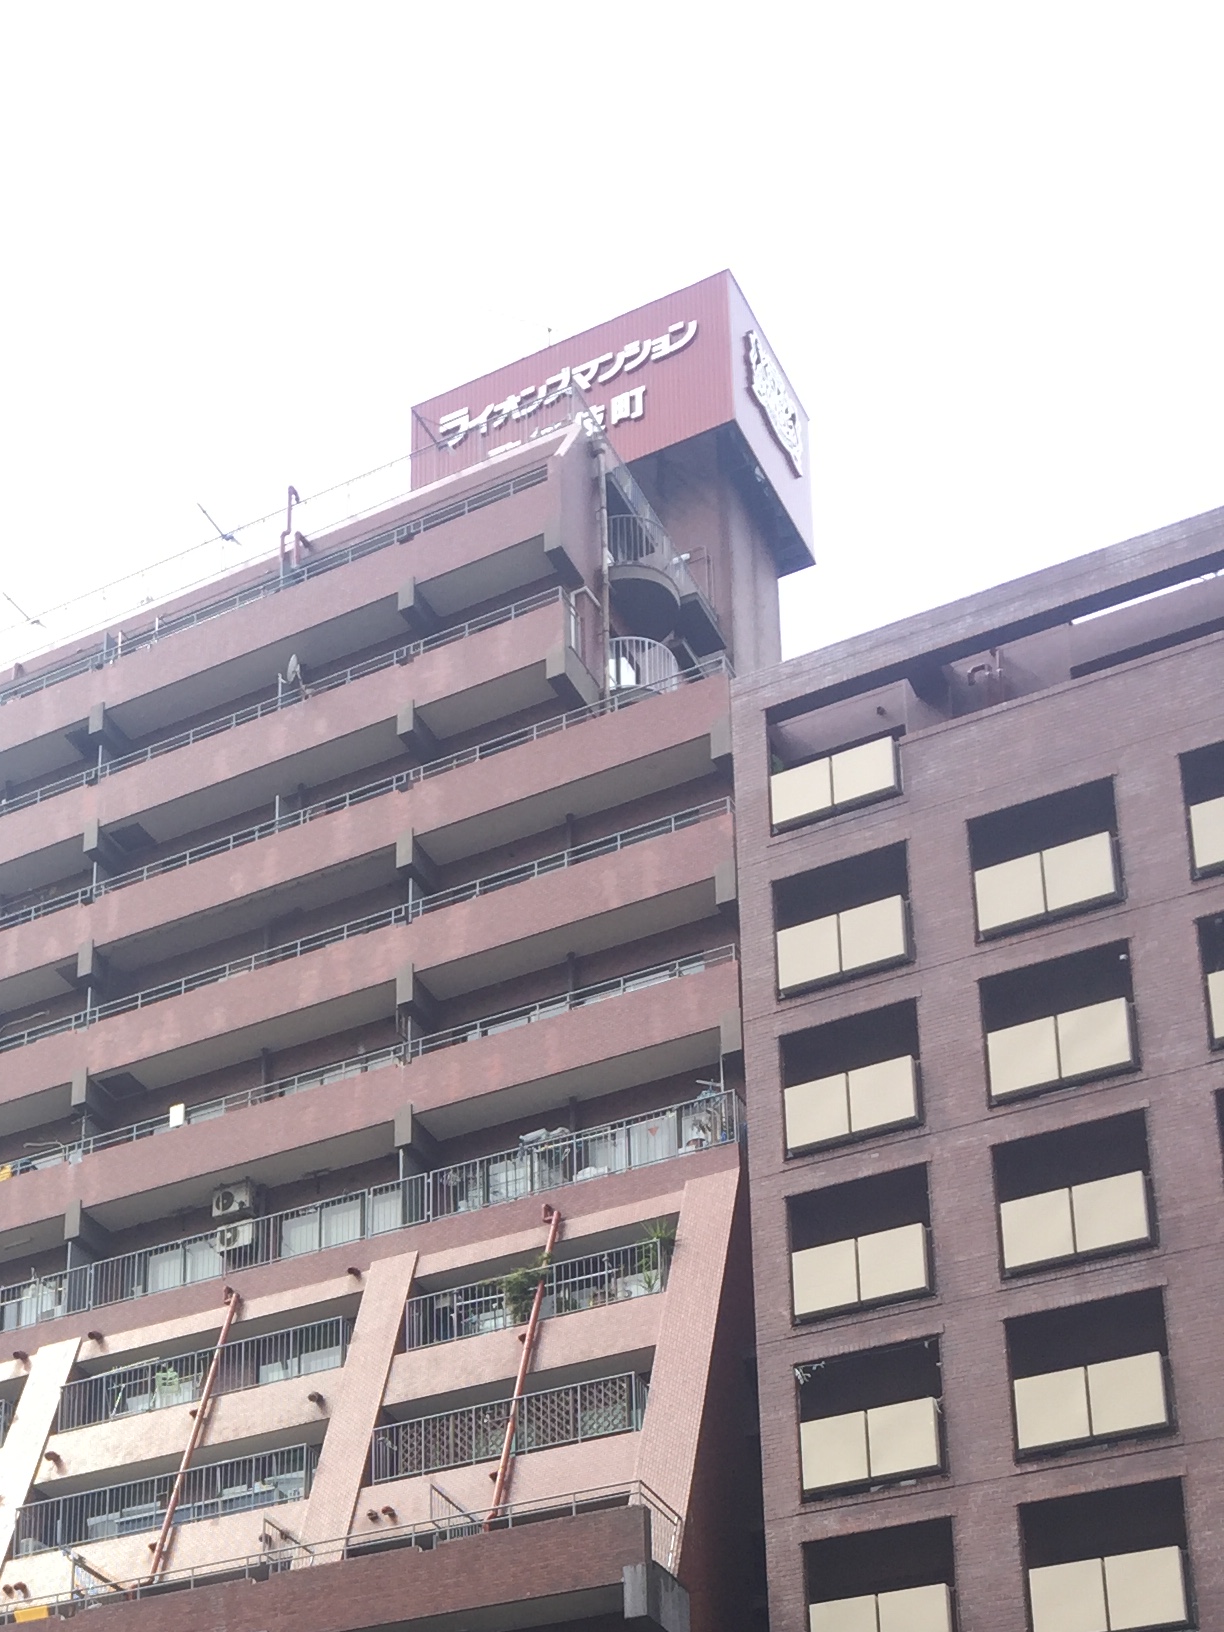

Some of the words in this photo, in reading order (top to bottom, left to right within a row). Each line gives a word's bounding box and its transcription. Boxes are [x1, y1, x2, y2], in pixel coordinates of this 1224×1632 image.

[439, 320, 698, 450] ライオンズマンション
